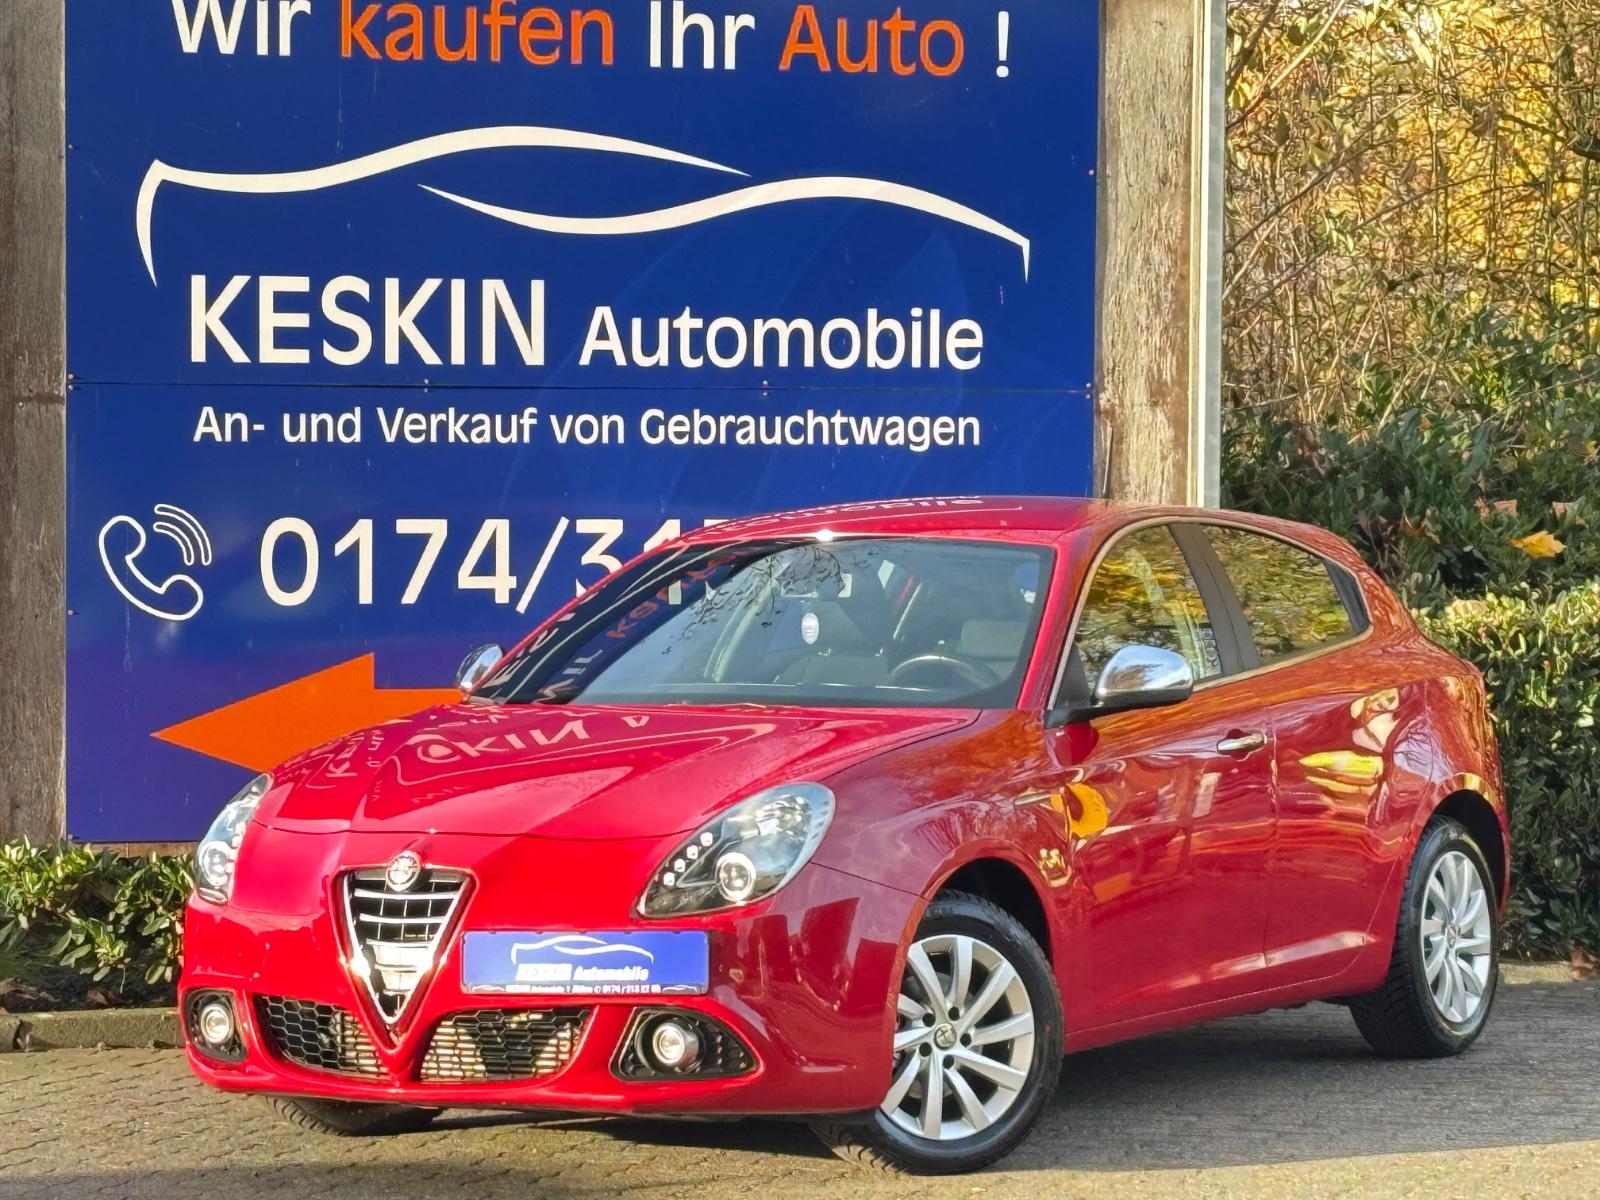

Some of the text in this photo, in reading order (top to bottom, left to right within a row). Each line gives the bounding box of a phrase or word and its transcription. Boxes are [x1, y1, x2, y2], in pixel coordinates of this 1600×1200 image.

[172, 0, 312, 57] Wir
[341, 0, 615, 66] kaufen
[649, 0, 756, 70] Ihr
[778, 4, 966, 77] Auto
[190, 274, 985, 371] KESKIN Automobile
[193, 406, 981, 453] An- und Verkauf von Gebrauchtwagen
